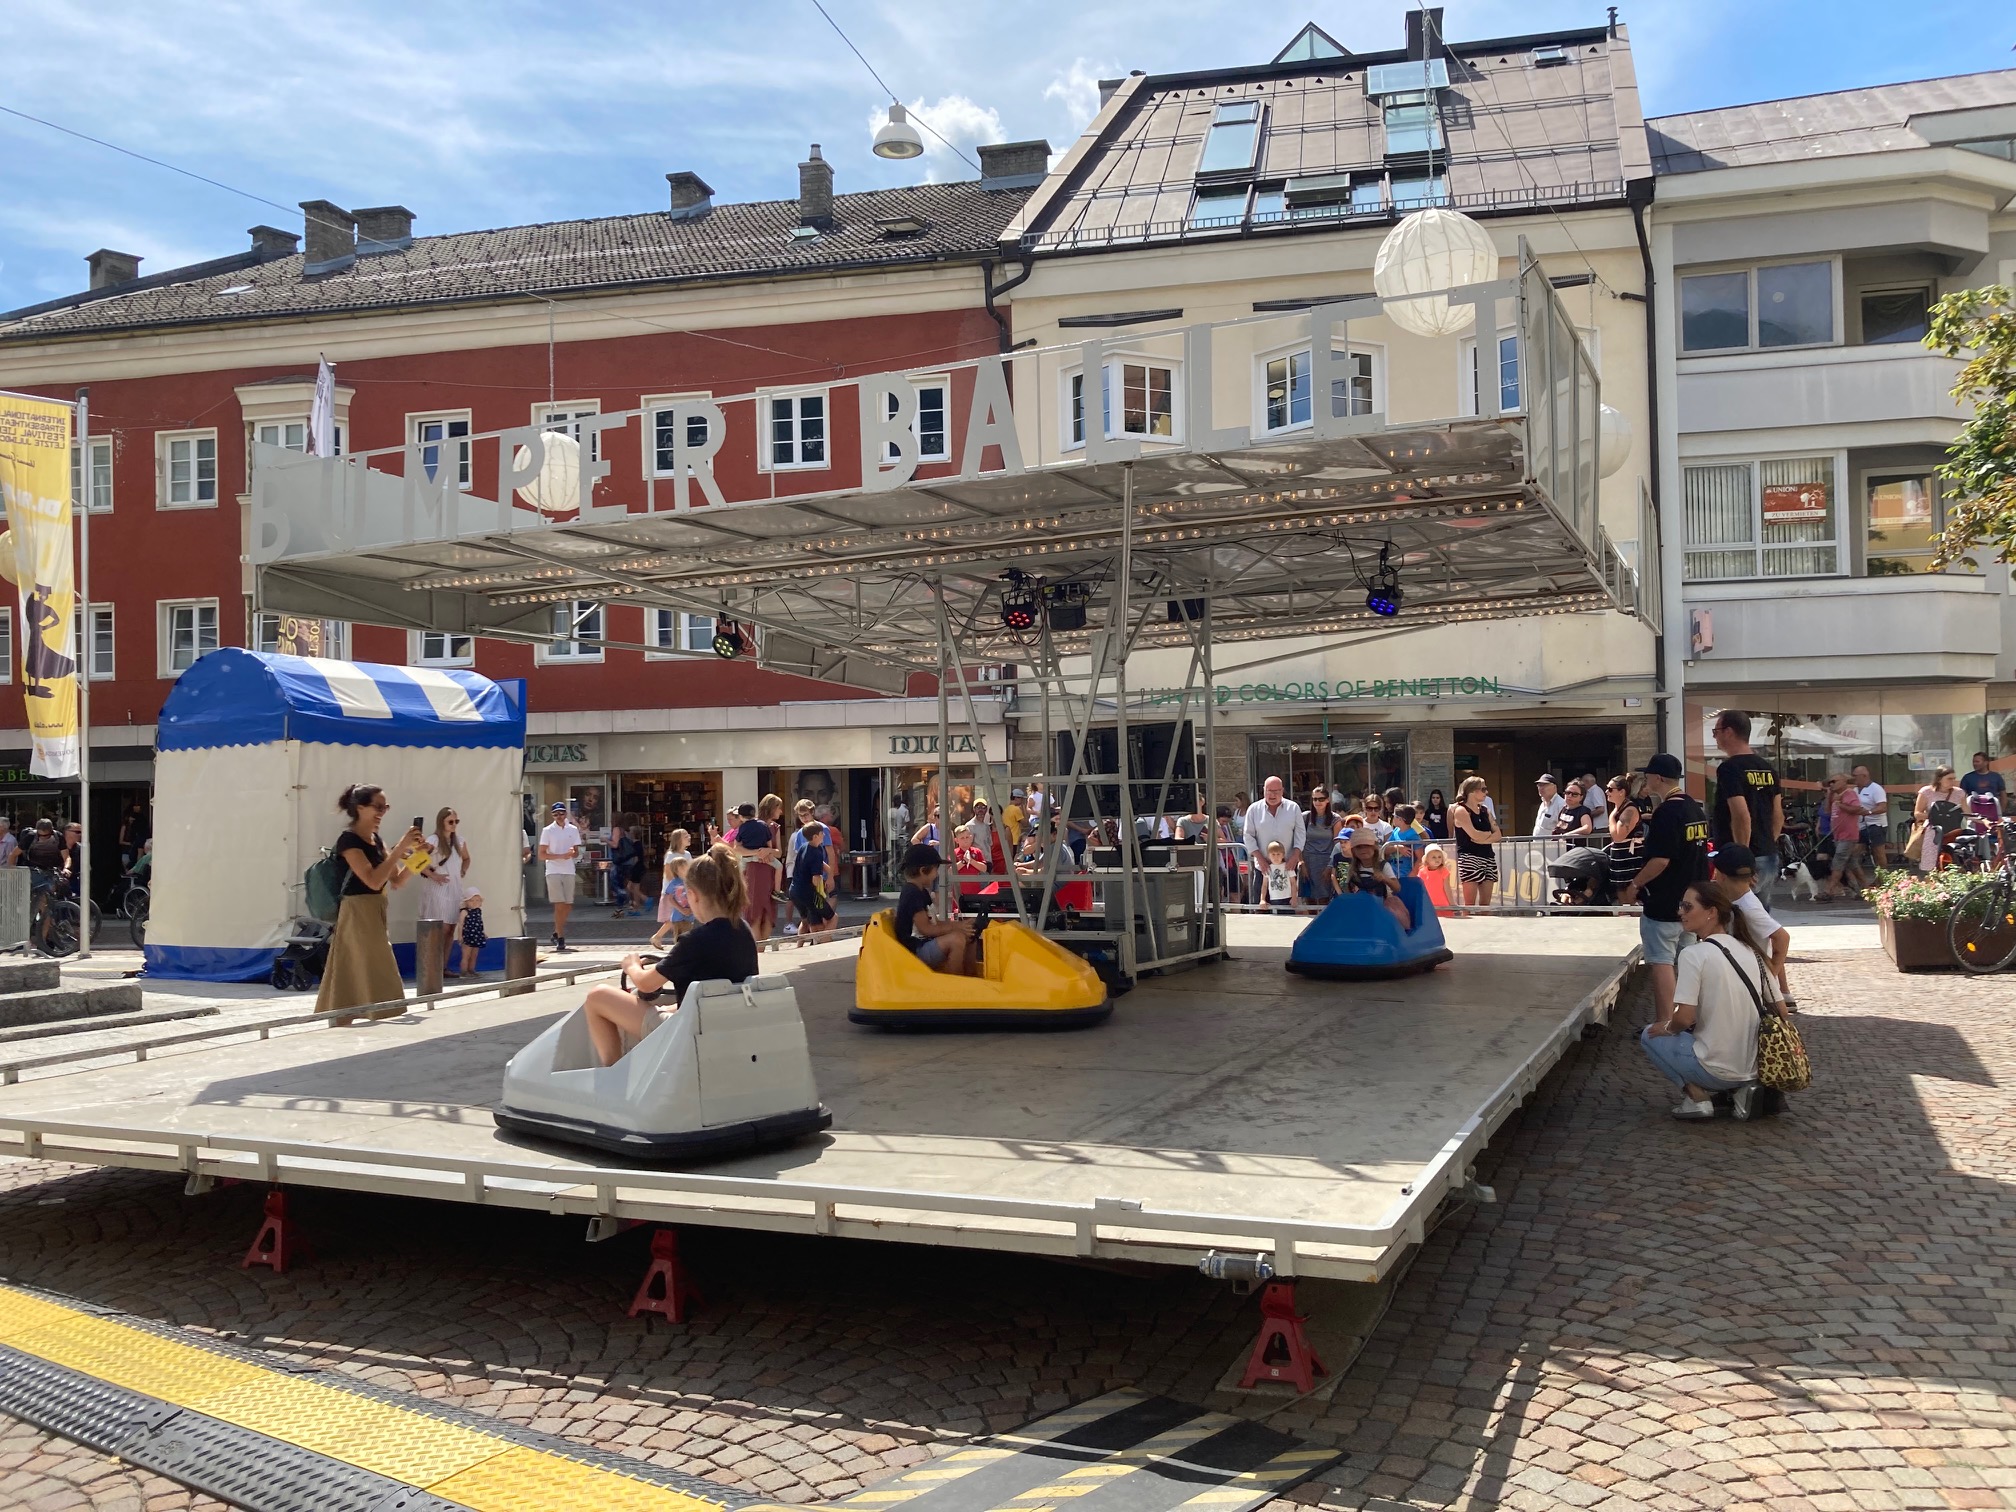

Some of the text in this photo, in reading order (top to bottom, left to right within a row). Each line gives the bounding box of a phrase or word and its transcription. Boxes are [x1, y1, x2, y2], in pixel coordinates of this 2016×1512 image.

[249, 279, 1519, 564] BUMPER BALLET
[1239, 681, 1328, 701] COLORS
[1336, 680, 1366, 698] OF
[1374, 676, 1499, 698] BENETTON
[889, 734, 986, 754] DOULA
